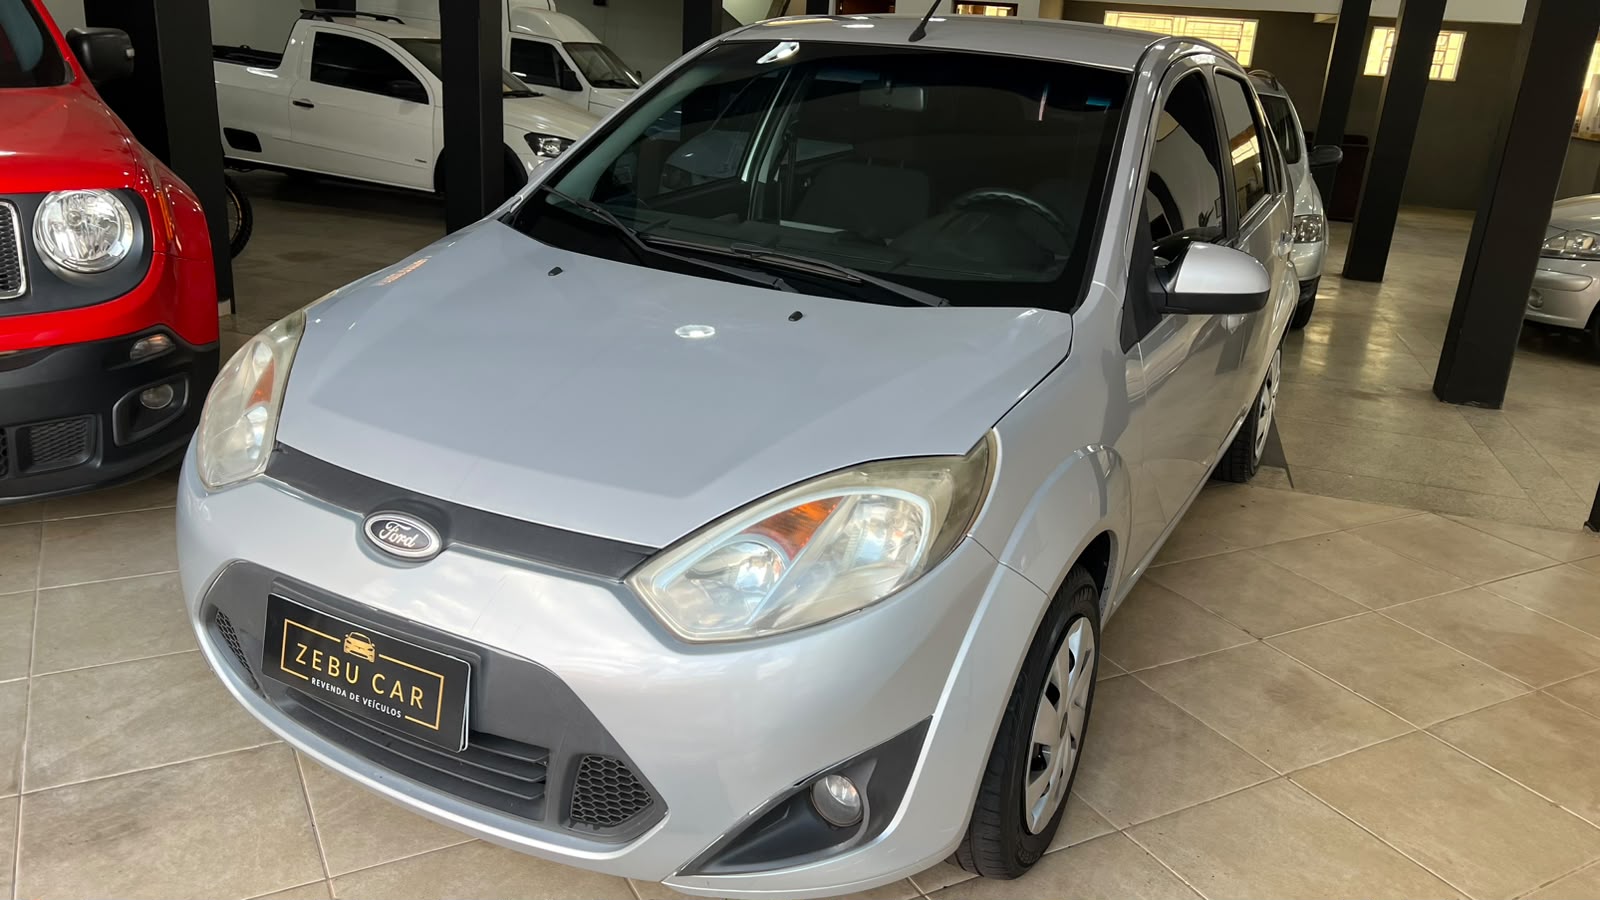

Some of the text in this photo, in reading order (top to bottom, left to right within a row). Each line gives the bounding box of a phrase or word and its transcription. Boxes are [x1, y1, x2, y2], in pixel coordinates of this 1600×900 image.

[379, 521, 418, 547] Ford
[295, 642, 423, 709] ZEBU CAR
[311, 676, 402, 718] REVENDA DE VEÍCULOS
